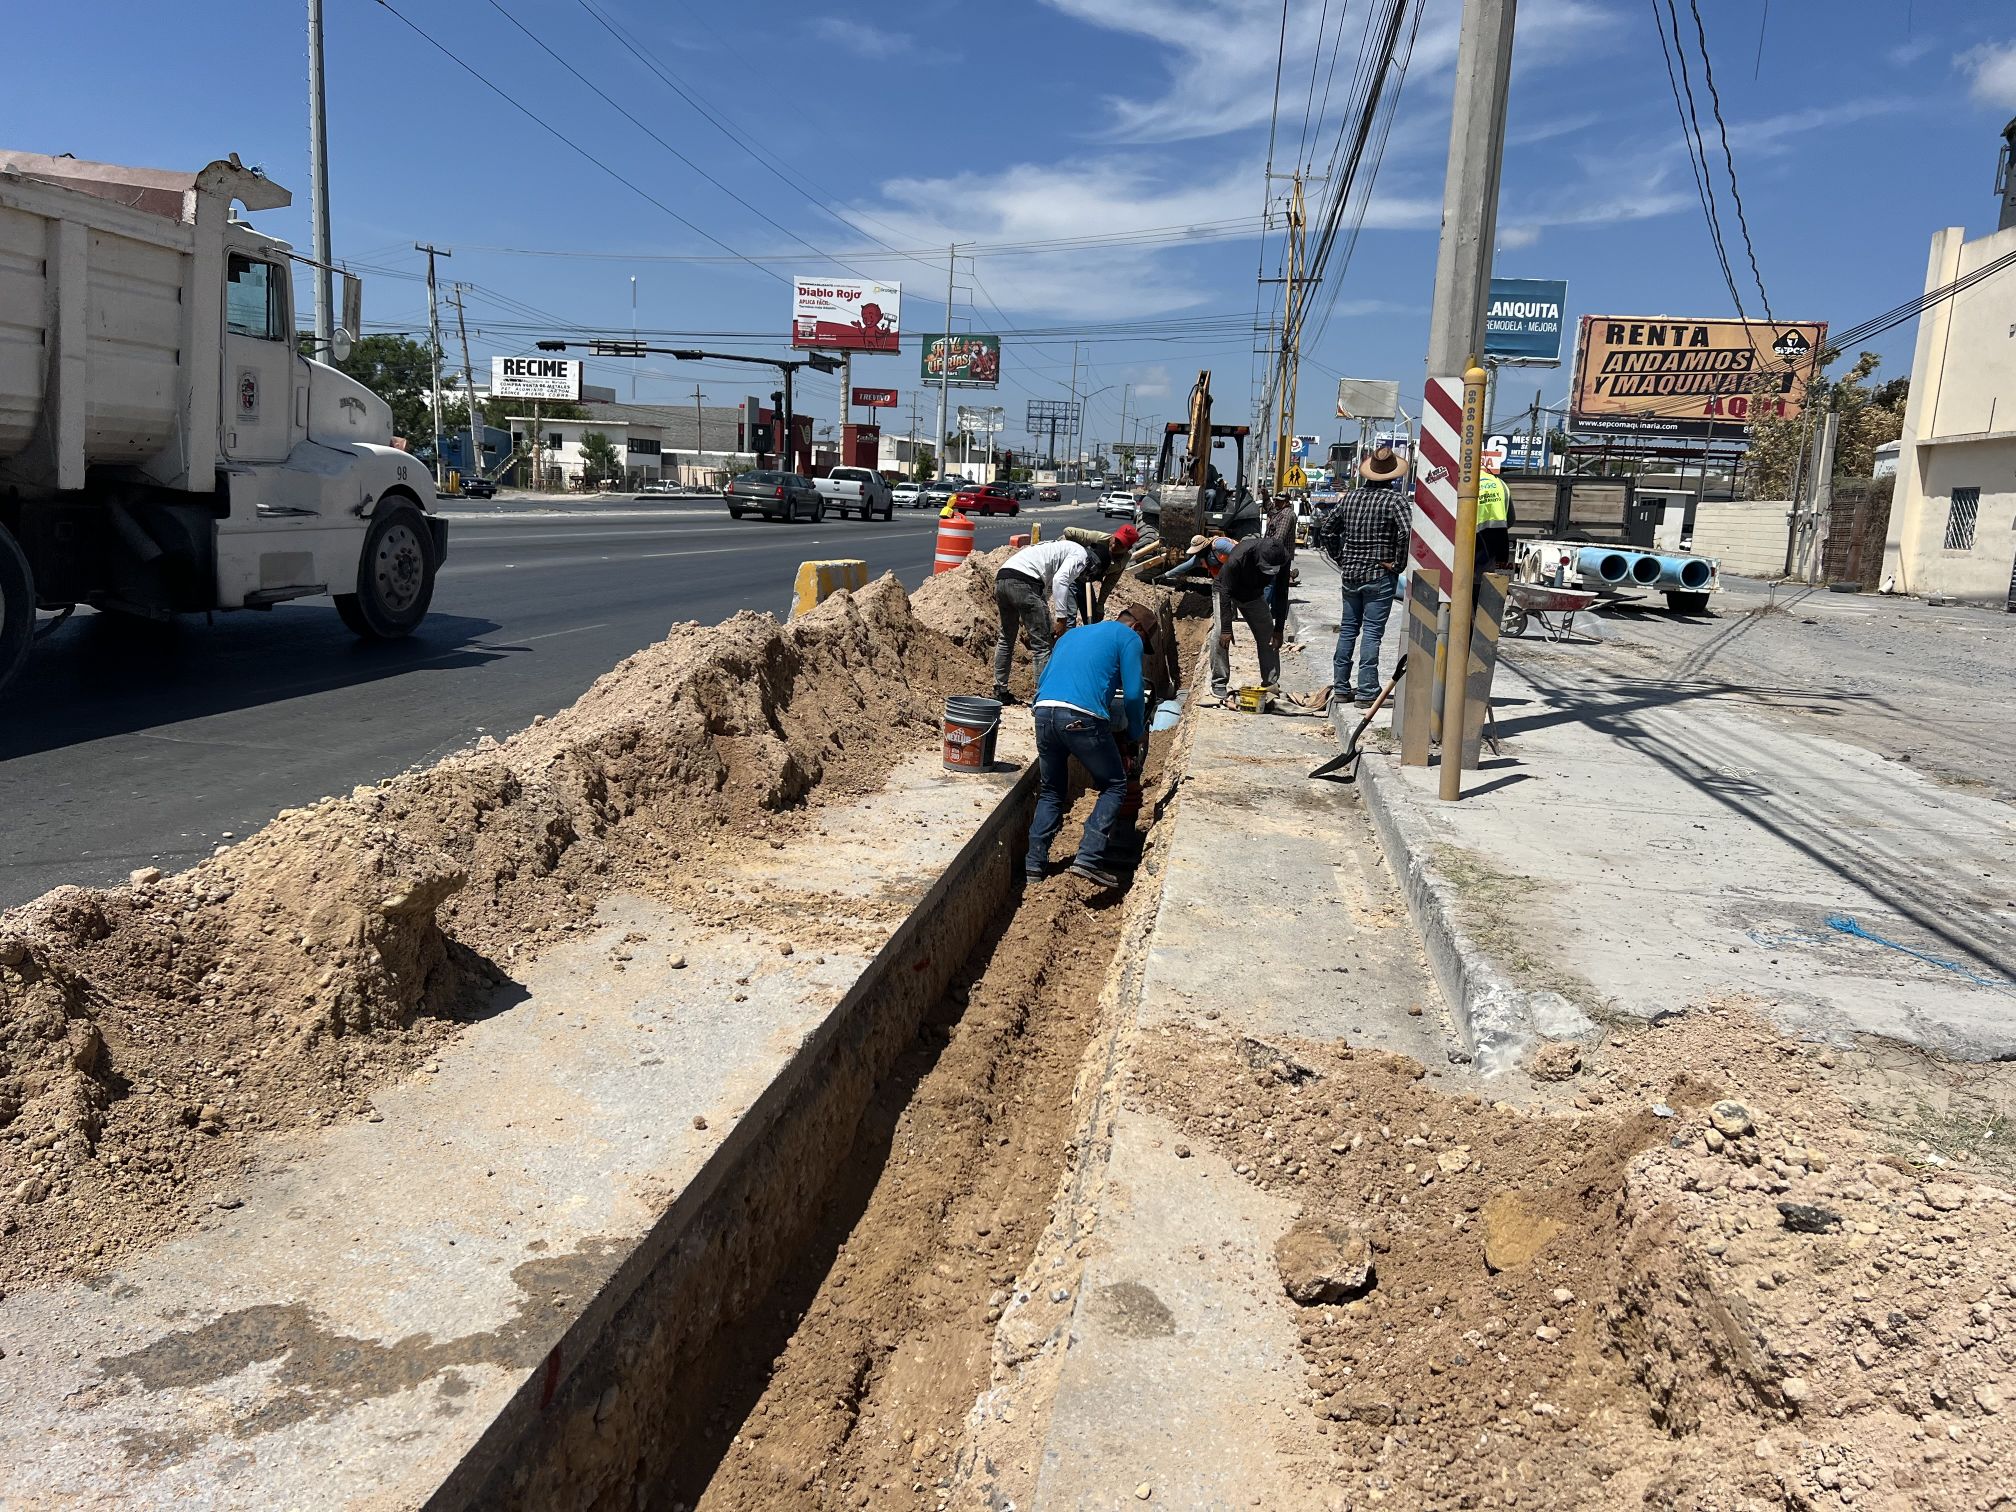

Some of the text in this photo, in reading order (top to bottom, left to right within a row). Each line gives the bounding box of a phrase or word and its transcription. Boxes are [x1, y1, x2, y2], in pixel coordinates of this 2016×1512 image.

[797, 287, 862, 302] Diablo Rojo
[1487, 301, 1559, 319] ANQUITA
[1527, 321, 1558, 333] MEJORA
[1605, 323, 1710, 348] RENTA
[503, 358, 568, 378] RECIME
[1604, 351, 1752, 373] ANDAMIOS
[1593, 376, 1610, 395] Y
[1463, 390, 1477, 483] 01800 909 99 99
[396, 465, 408, 481] 98
